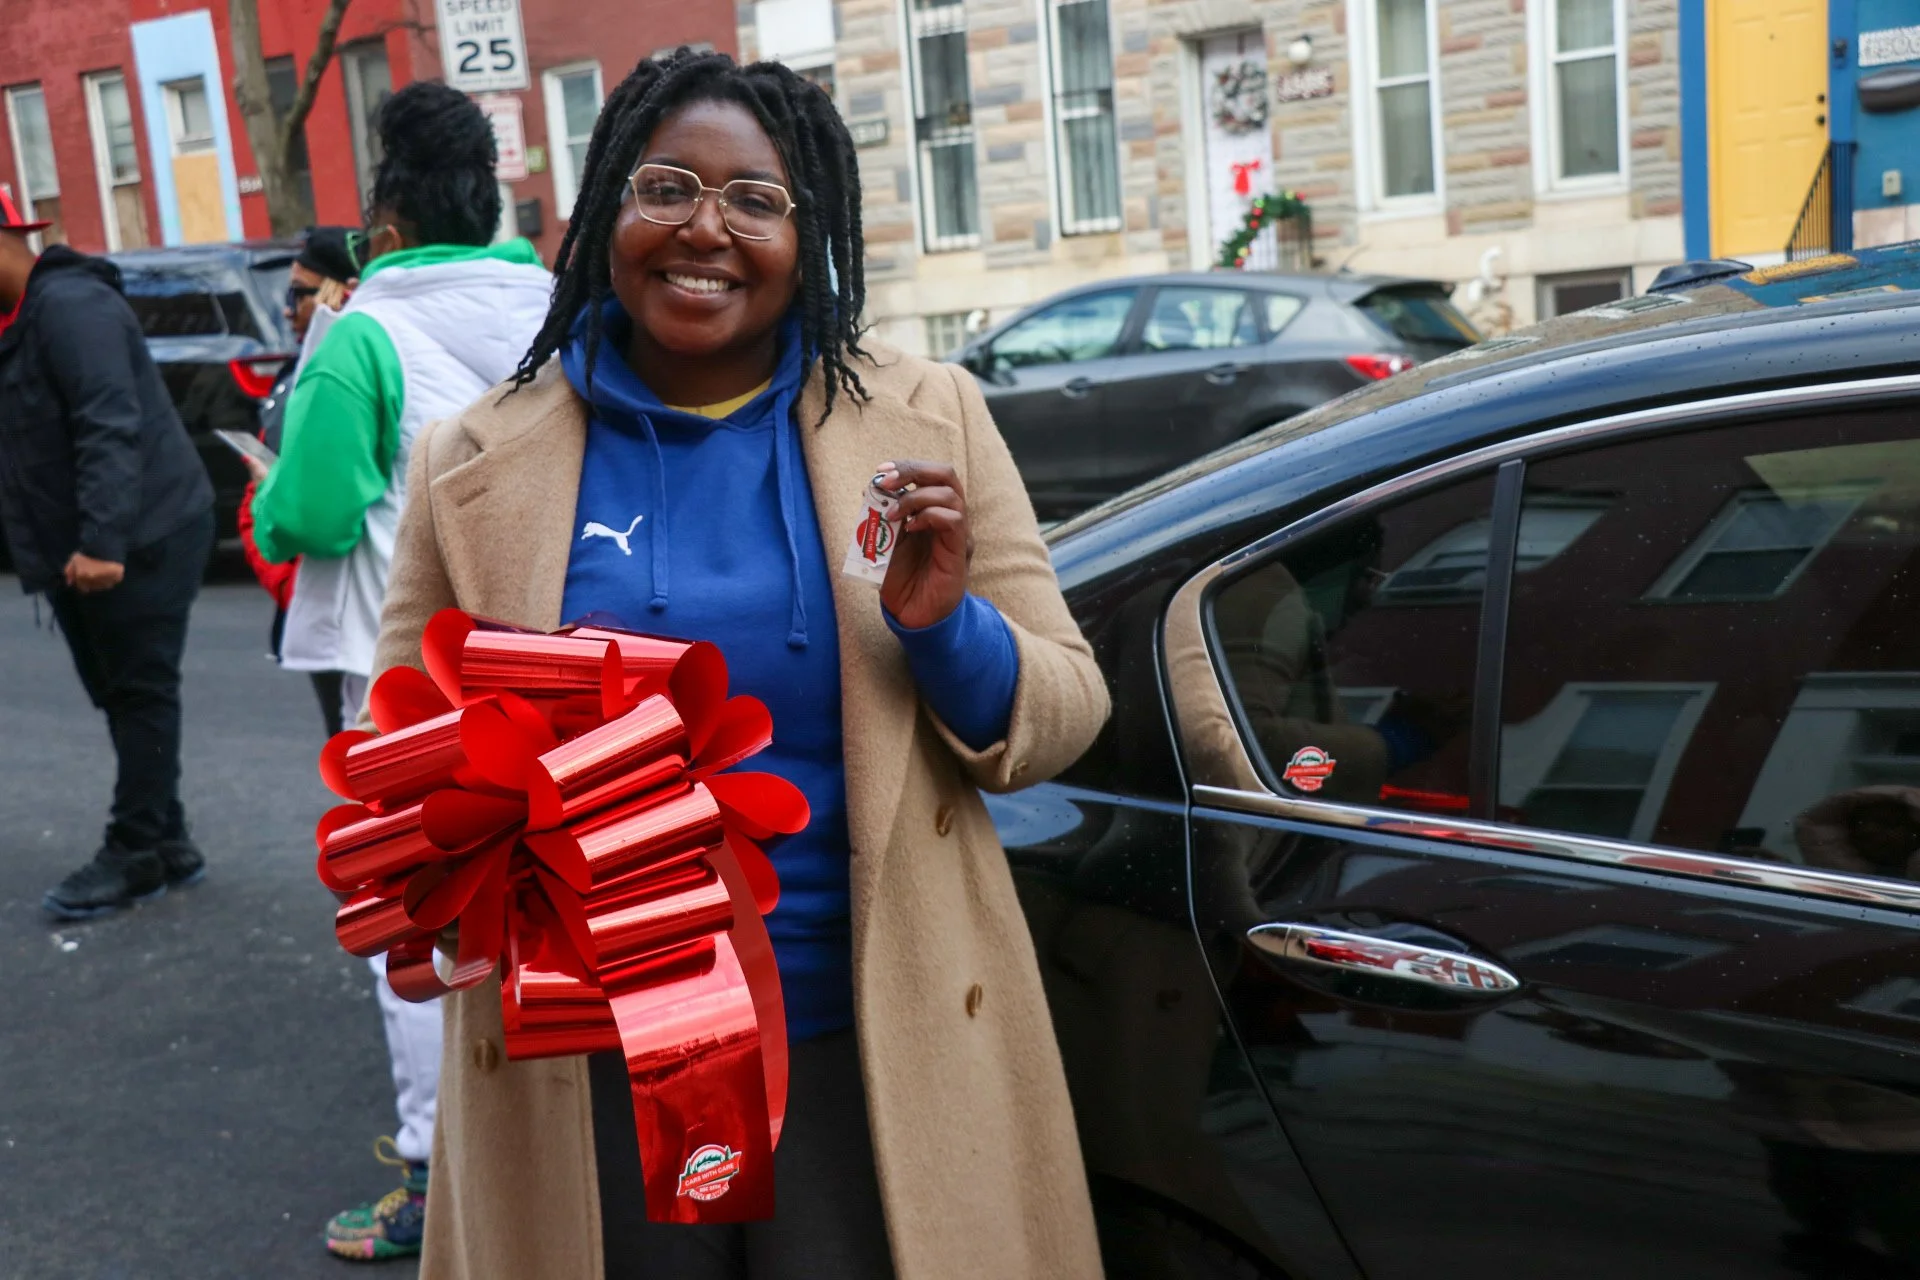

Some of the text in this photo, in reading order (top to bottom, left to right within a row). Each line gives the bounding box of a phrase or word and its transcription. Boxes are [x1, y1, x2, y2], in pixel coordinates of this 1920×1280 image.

[446, 0, 513, 15] SPEED
[456, 18, 504, 35] LIMIT
[457, 38, 516, 74] 25
[685, 1162, 735, 1187] CARS WITH CARE
